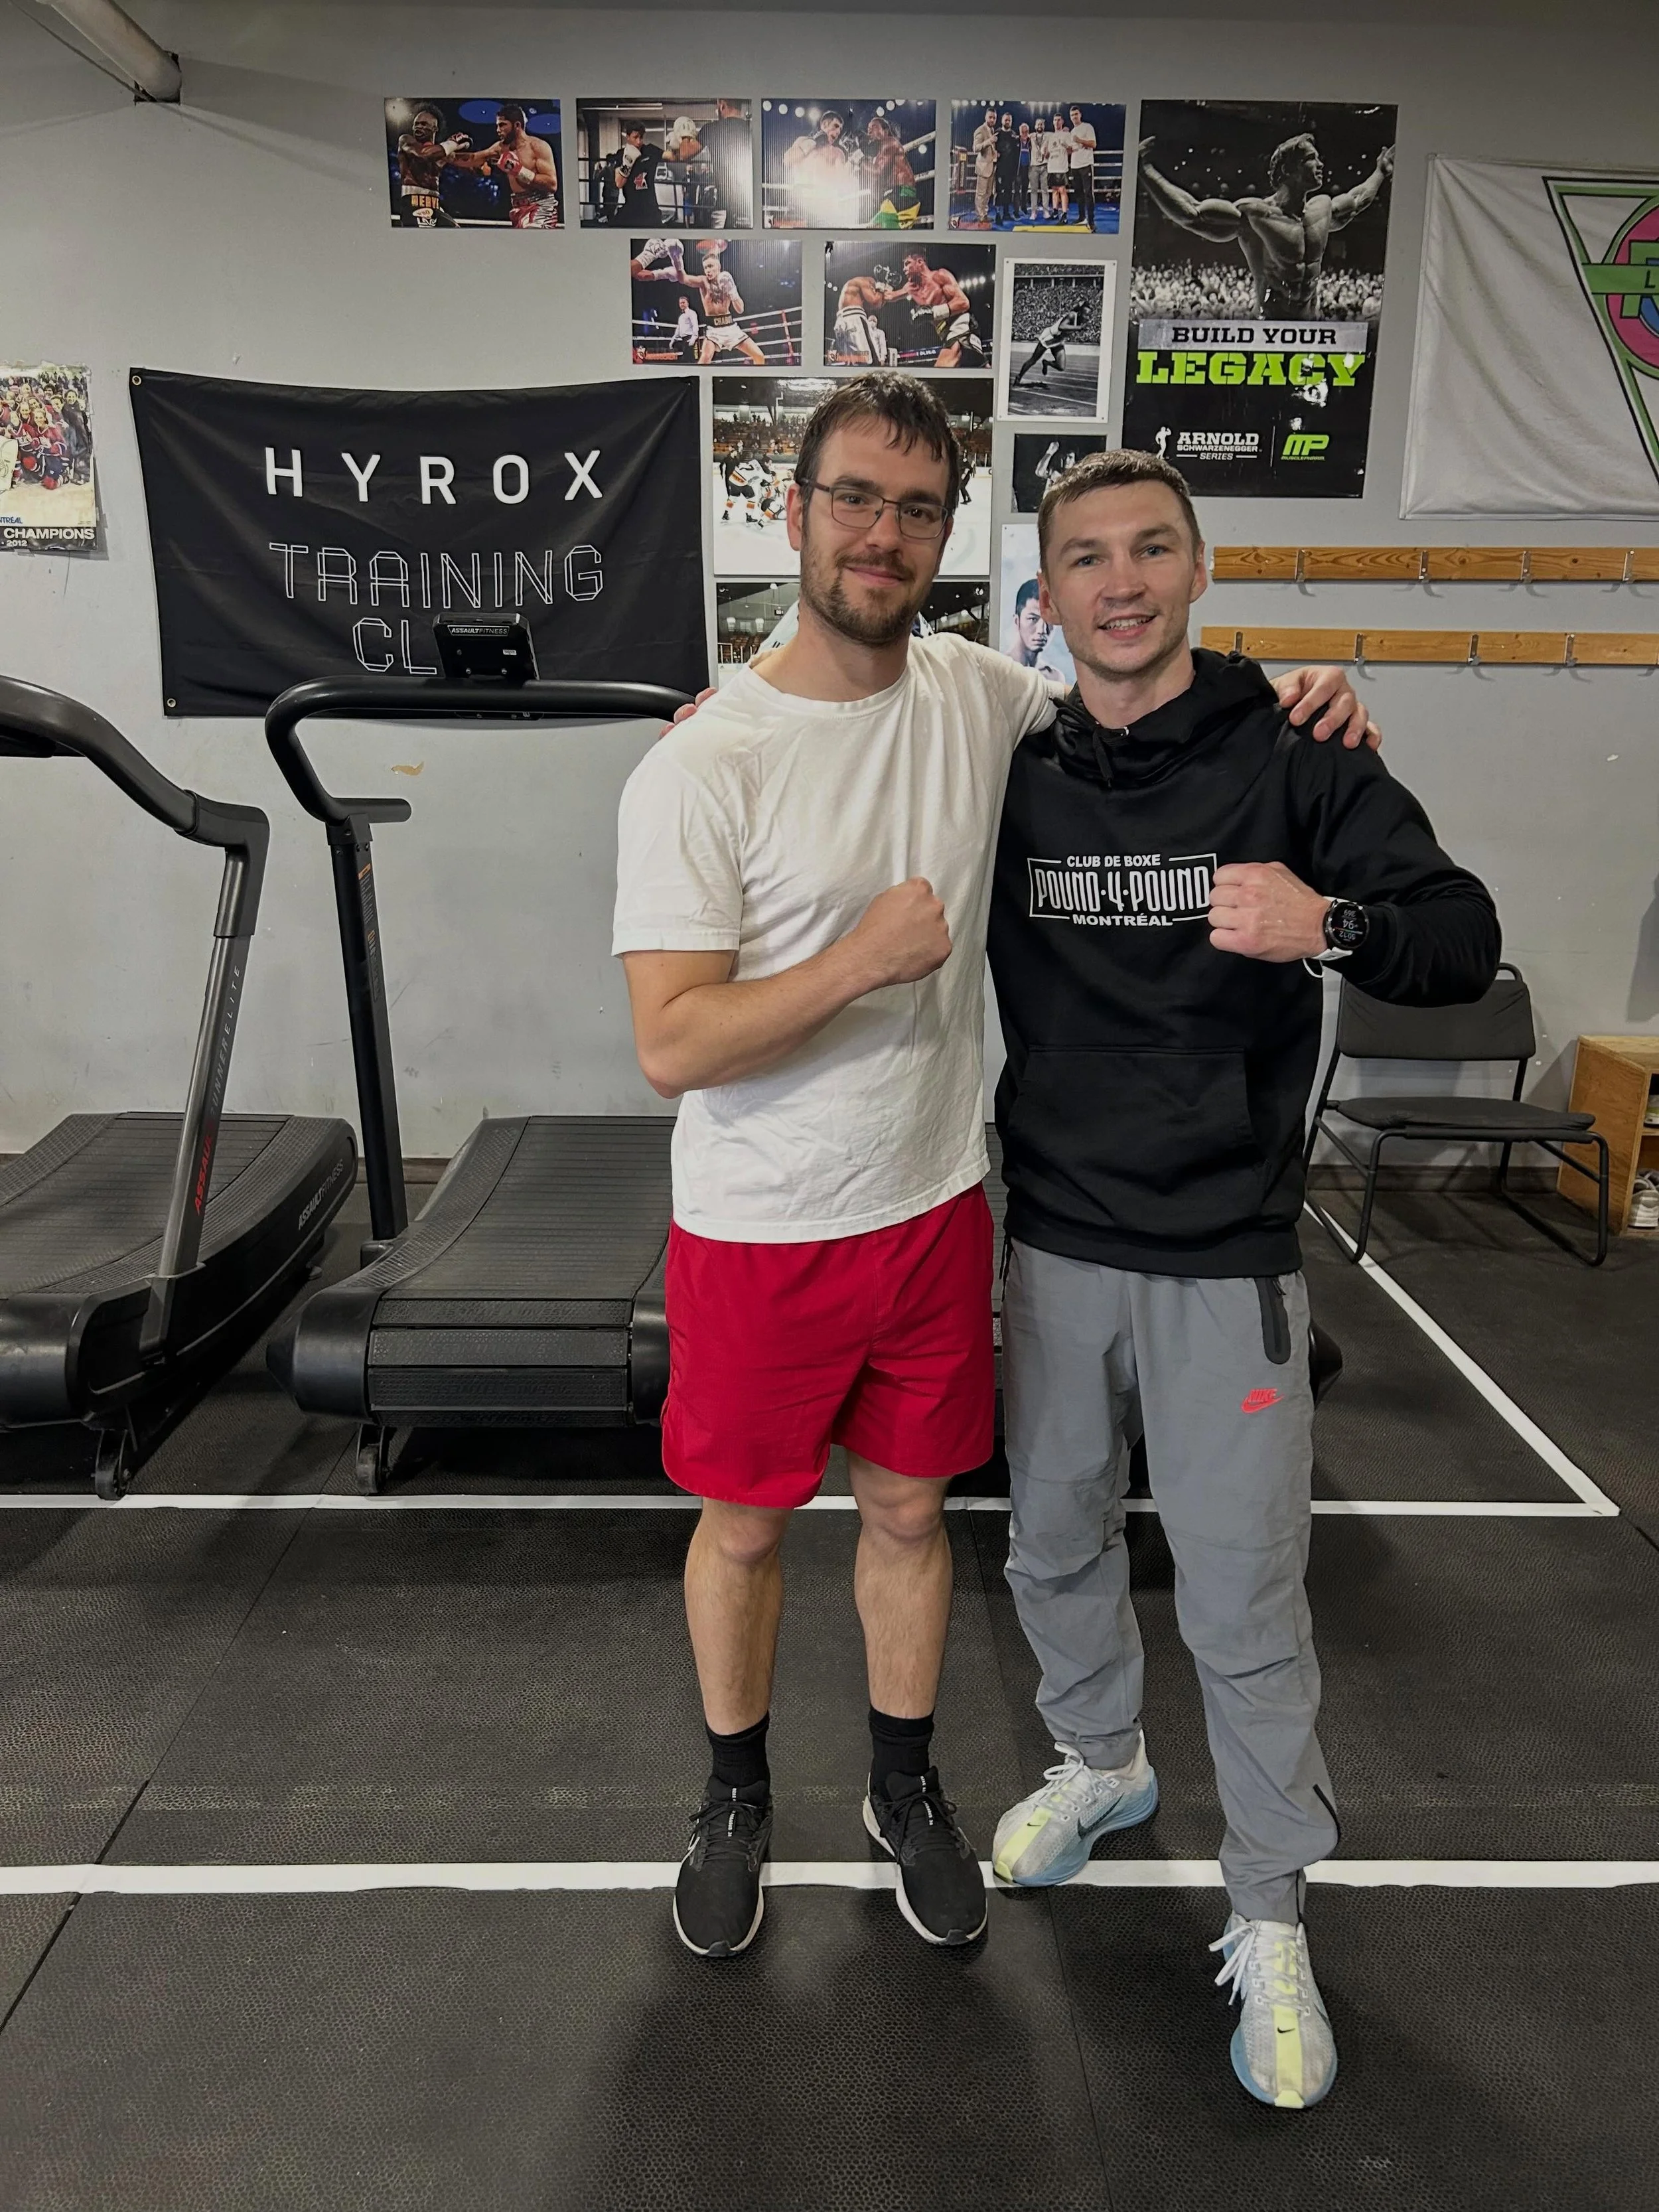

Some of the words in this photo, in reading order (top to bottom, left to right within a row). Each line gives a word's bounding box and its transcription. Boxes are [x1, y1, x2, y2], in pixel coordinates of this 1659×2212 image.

[1172, 327, 1254, 343] BUILD
[1263, 328, 1336, 344] YOUR
[1136, 351, 1366, 387] LEGACY
[1177, 432, 1259, 445] ARNOLD
[265, 447, 603, 504] HYROX
[3, 528, 96, 540] CHAMPIONS
[269, 542, 603, 609] TRAINING
[1066, 855, 1101, 867] CLUB
[1104, 855, 1121, 867] DE
[1123, 854, 1161, 867] BOXE
[1072, 913, 1173, 926] MONTRÉAL
